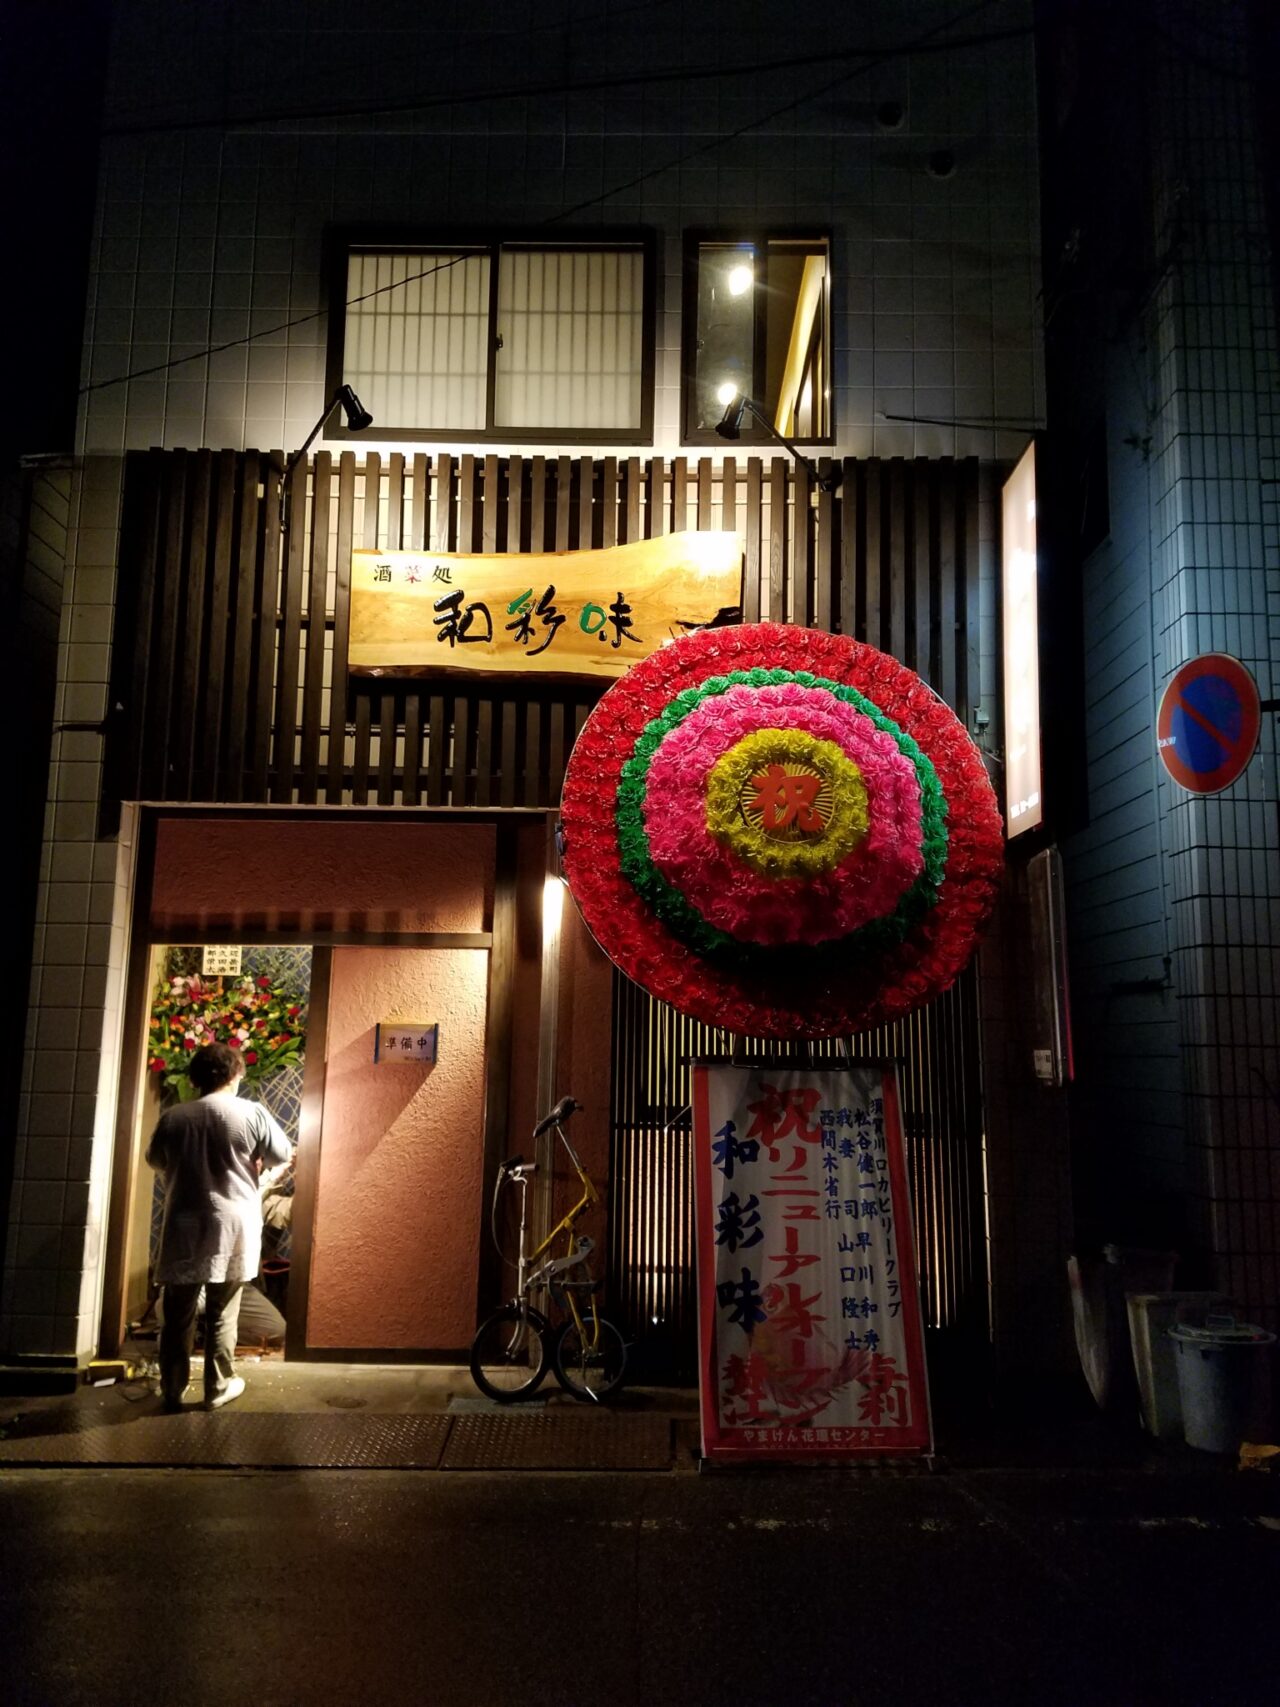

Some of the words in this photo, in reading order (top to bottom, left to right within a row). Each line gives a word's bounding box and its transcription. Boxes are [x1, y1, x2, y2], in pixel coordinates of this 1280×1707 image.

[433, 584, 643, 657] 和彩味
[748, 764, 825, 832] 祝
[385, 1036, 427, 1051] 準備中
